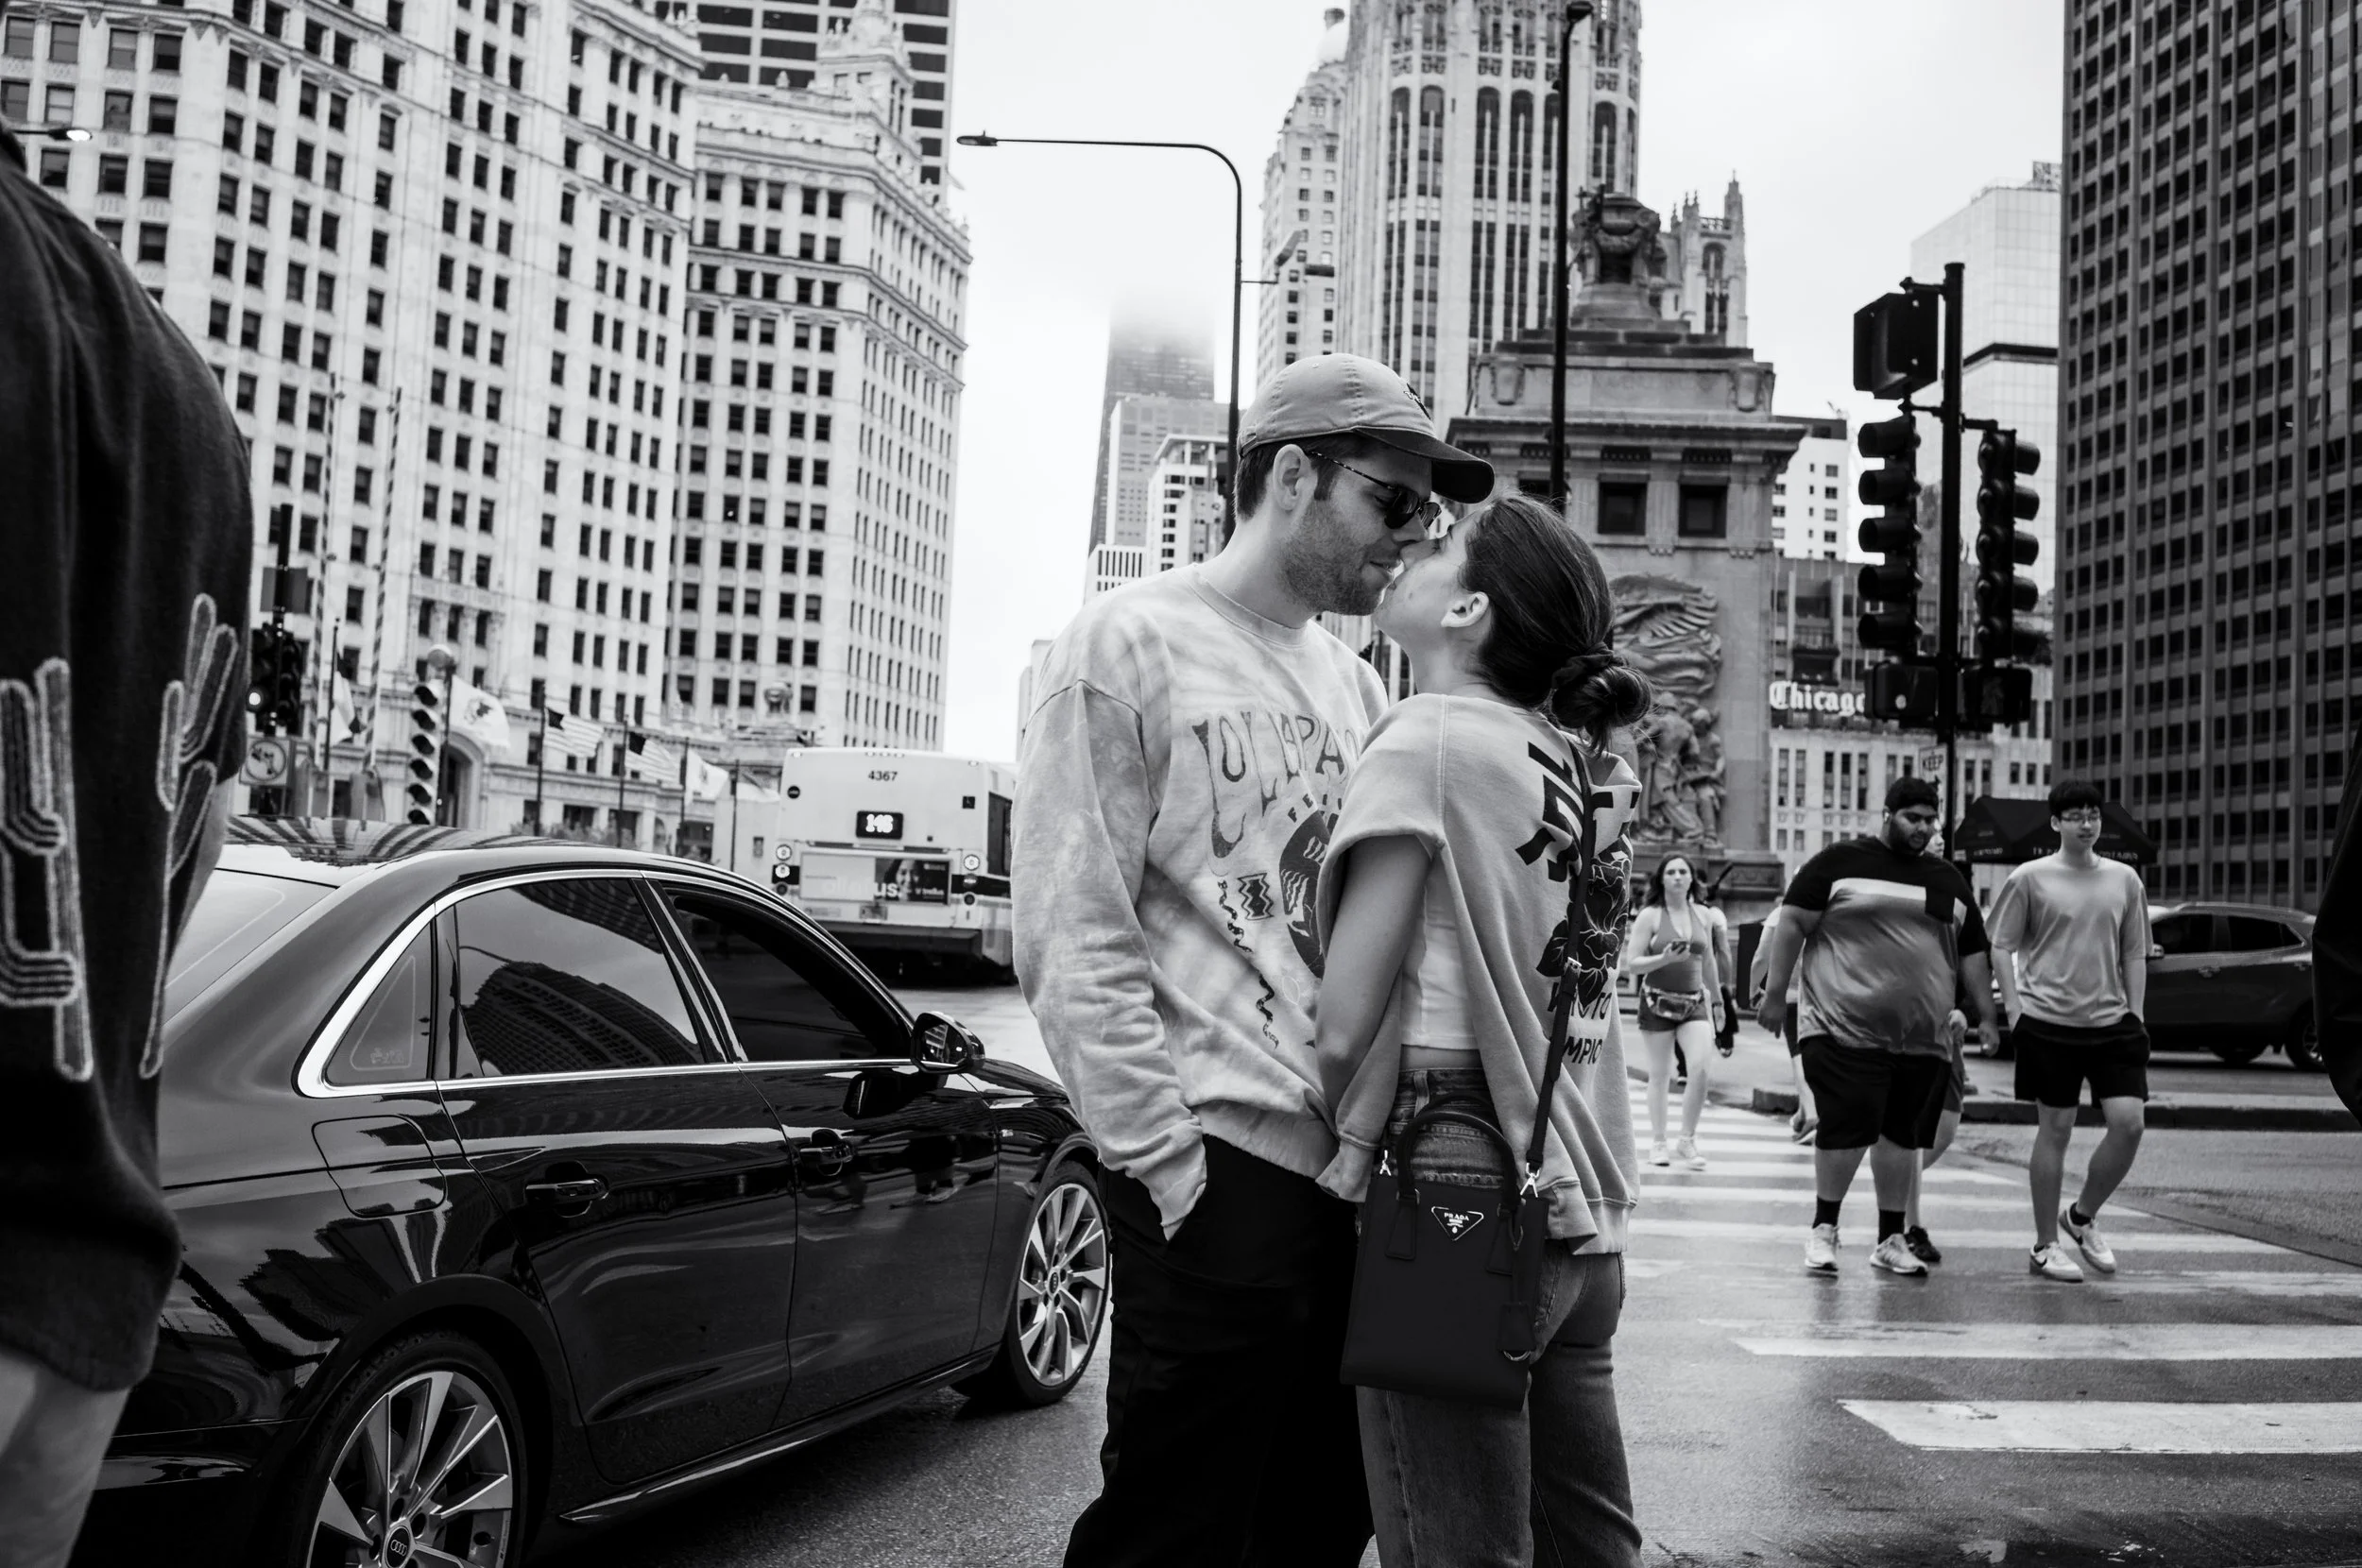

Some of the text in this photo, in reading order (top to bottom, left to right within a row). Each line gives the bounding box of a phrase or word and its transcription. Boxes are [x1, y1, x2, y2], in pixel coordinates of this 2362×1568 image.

[1922, 753, 1944, 772] KEEP
[868, 770, 898, 781] 4367
[1444, 1212, 1470, 1220] PRADA
